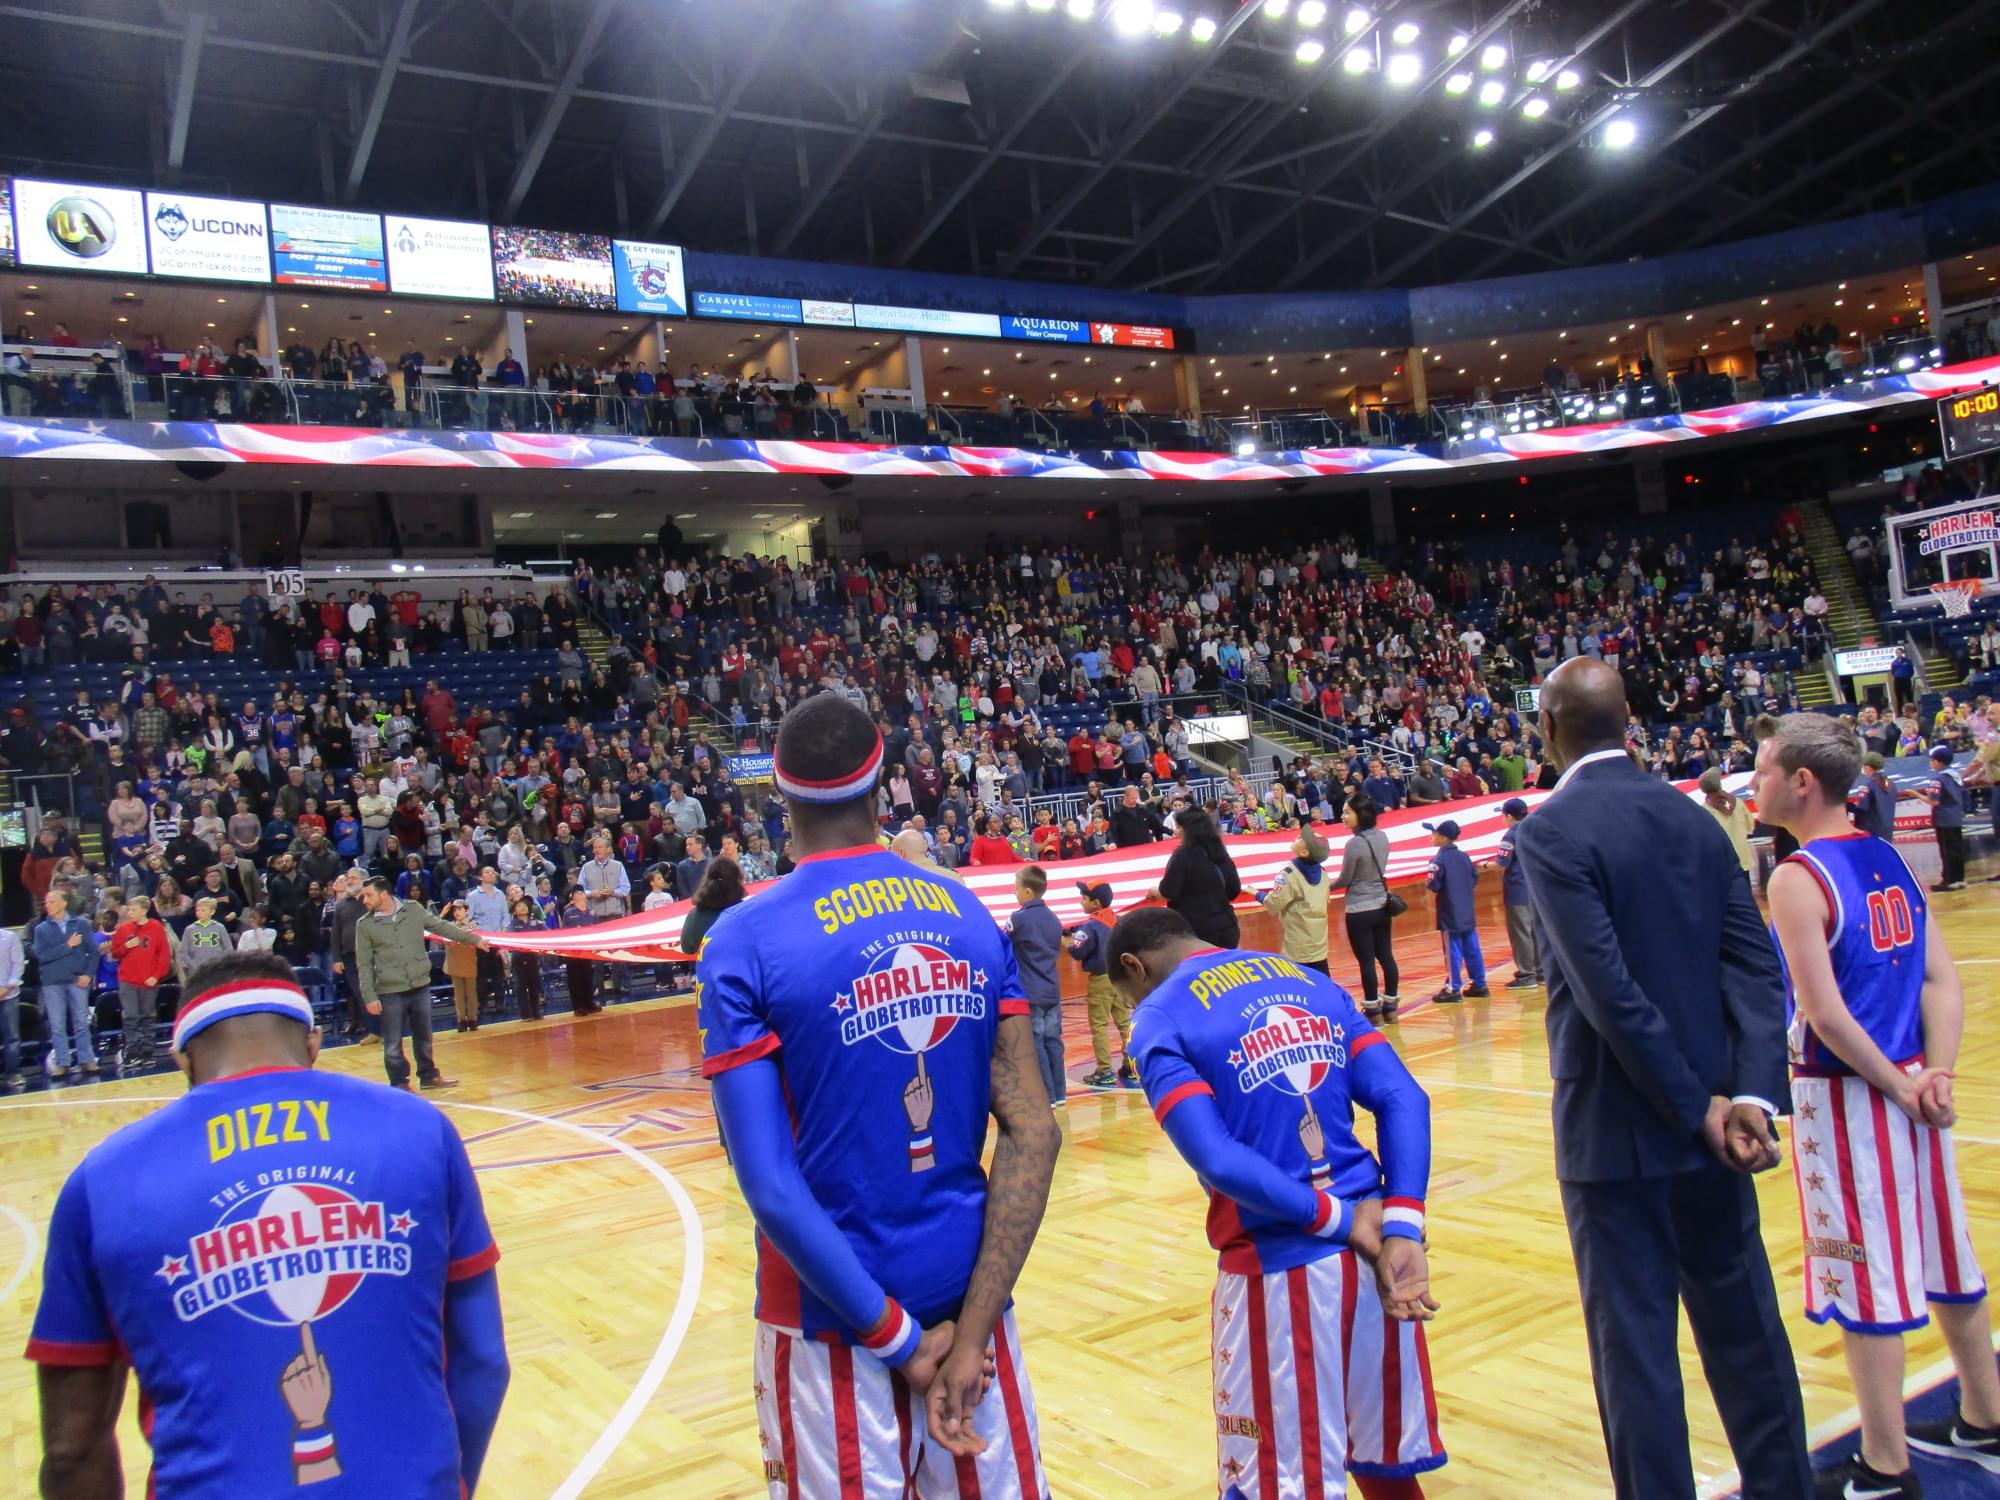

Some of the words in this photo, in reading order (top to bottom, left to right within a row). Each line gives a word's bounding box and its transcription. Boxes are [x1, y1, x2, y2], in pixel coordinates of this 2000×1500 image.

[192, 218, 263, 237] UCONN
[425, 231, 487, 243] Advanced
[159, 258, 264, 273] UConnTickets.com
[315, 264, 344, 272] FERRY
[1012, 317, 1079, 332] AQUARION
[1026, 329, 1042, 337] Water
[1044, 330, 1068, 341] Company
[1953, 392, 1998, 418] 10:00
[1931, 511, 1992, 538] HARLEM
[1921, 529, 2000, 554] GLOBETROTTER
[269, 573, 303, 594] 105
[247, 729, 259, 737] 36
[742, 757, 774, 767] HOUSATO
[1894, 818, 1932, 828] ALAXY.C
[815, 877, 961, 935] SCORPION
[1867, 886, 1913, 952] 00
[861, 940, 884, 960] THE
[887, 930, 951, 947] ORIGINAL
[855, 961, 968, 1010] HARLEM
[842, 994, 983, 1042] GLOBETROTTERS
[1240, 1003, 1256, 1019] THE
[1257, 993, 1309, 1008] ORIGINAL
[1243, 1017, 1331, 1062] HARLEM
[1240, 1044, 1345, 1091] GLOBETROTTERS
[207, 1100, 330, 1163] DIZZY
[209, 1180, 249, 1208] THE
[257, 1165, 357, 1186] ORIGINAL
[194, 1203, 382, 1275] HARLEM
[178, 1244, 411, 1316] GLOBETROTTERS
[1216, 1415, 1263, 1442] RLEM
